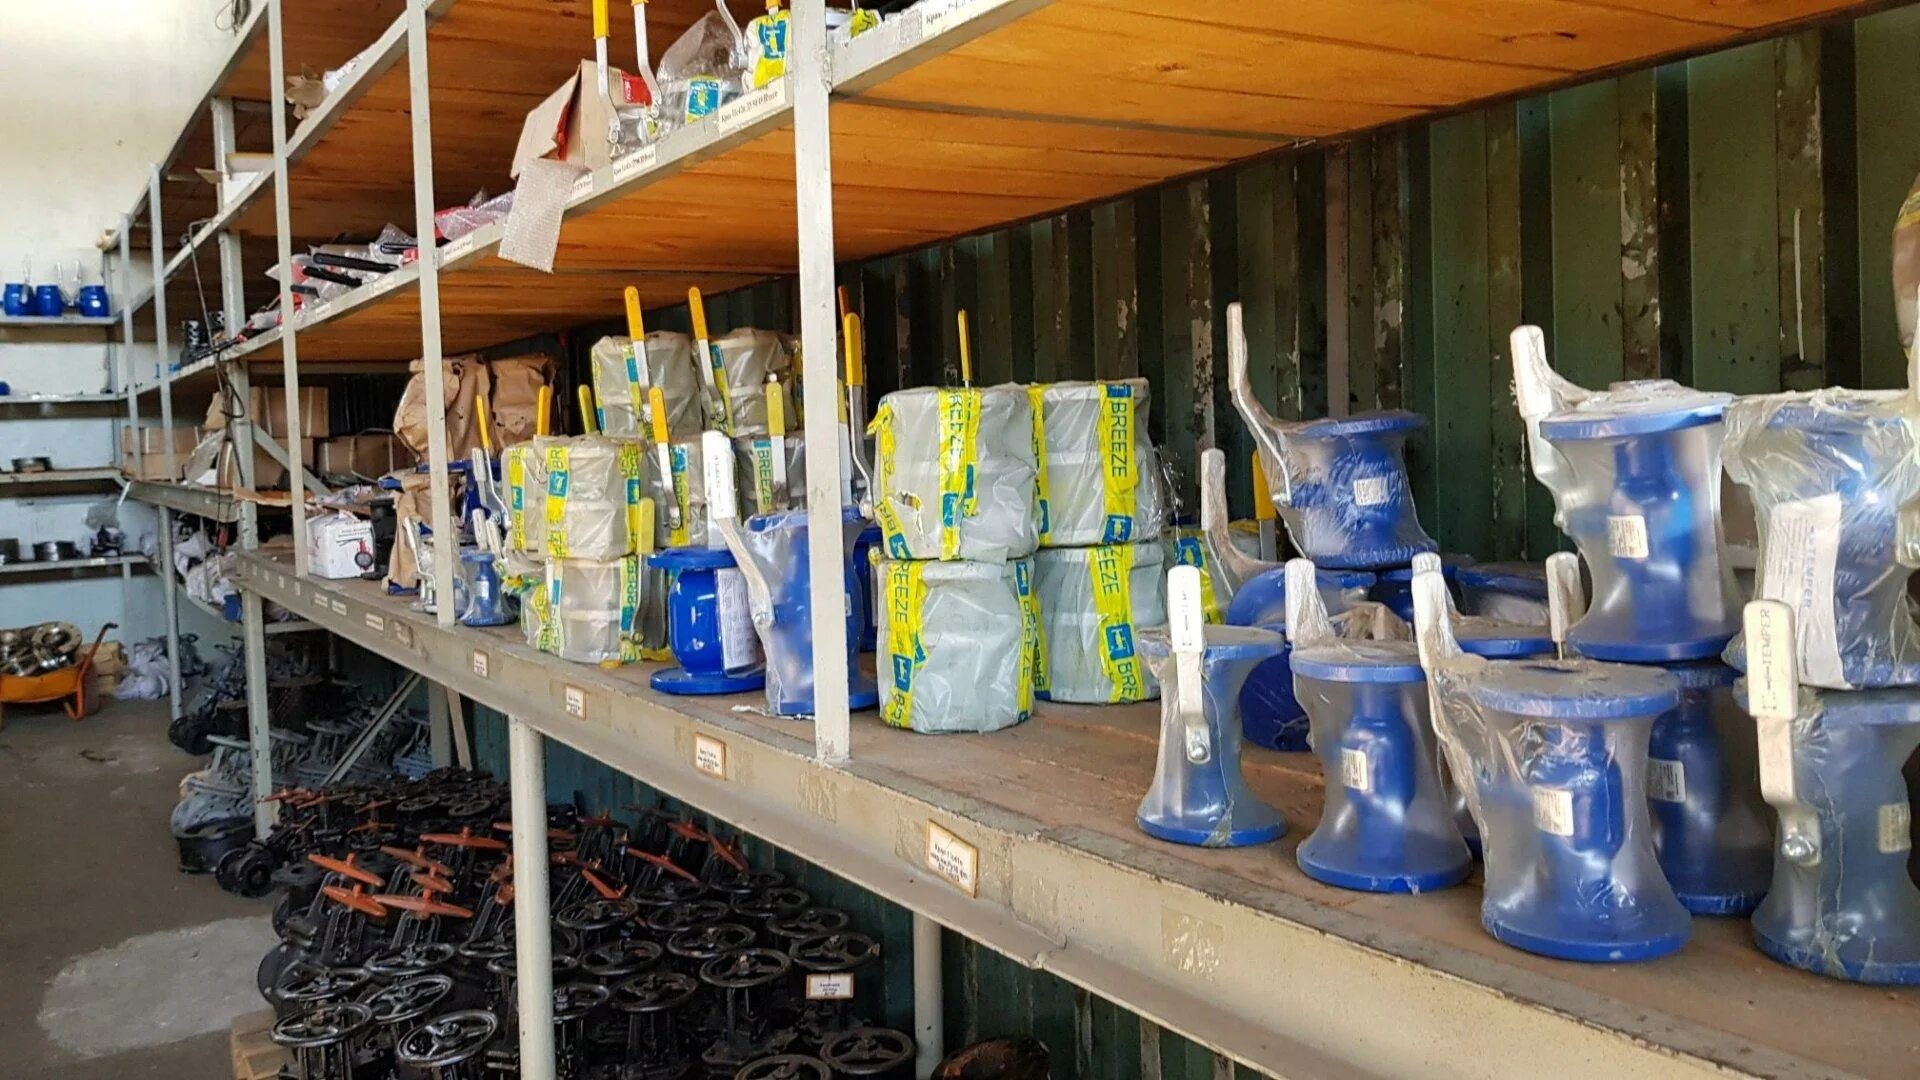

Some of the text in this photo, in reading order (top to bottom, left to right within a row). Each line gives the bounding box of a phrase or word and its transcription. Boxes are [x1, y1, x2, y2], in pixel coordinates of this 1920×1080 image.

[1110, 402, 1128, 478] BREEZE
[757, 449, 773, 506] BREEZE
[1759, 608, 1773, 665] TEMPER
